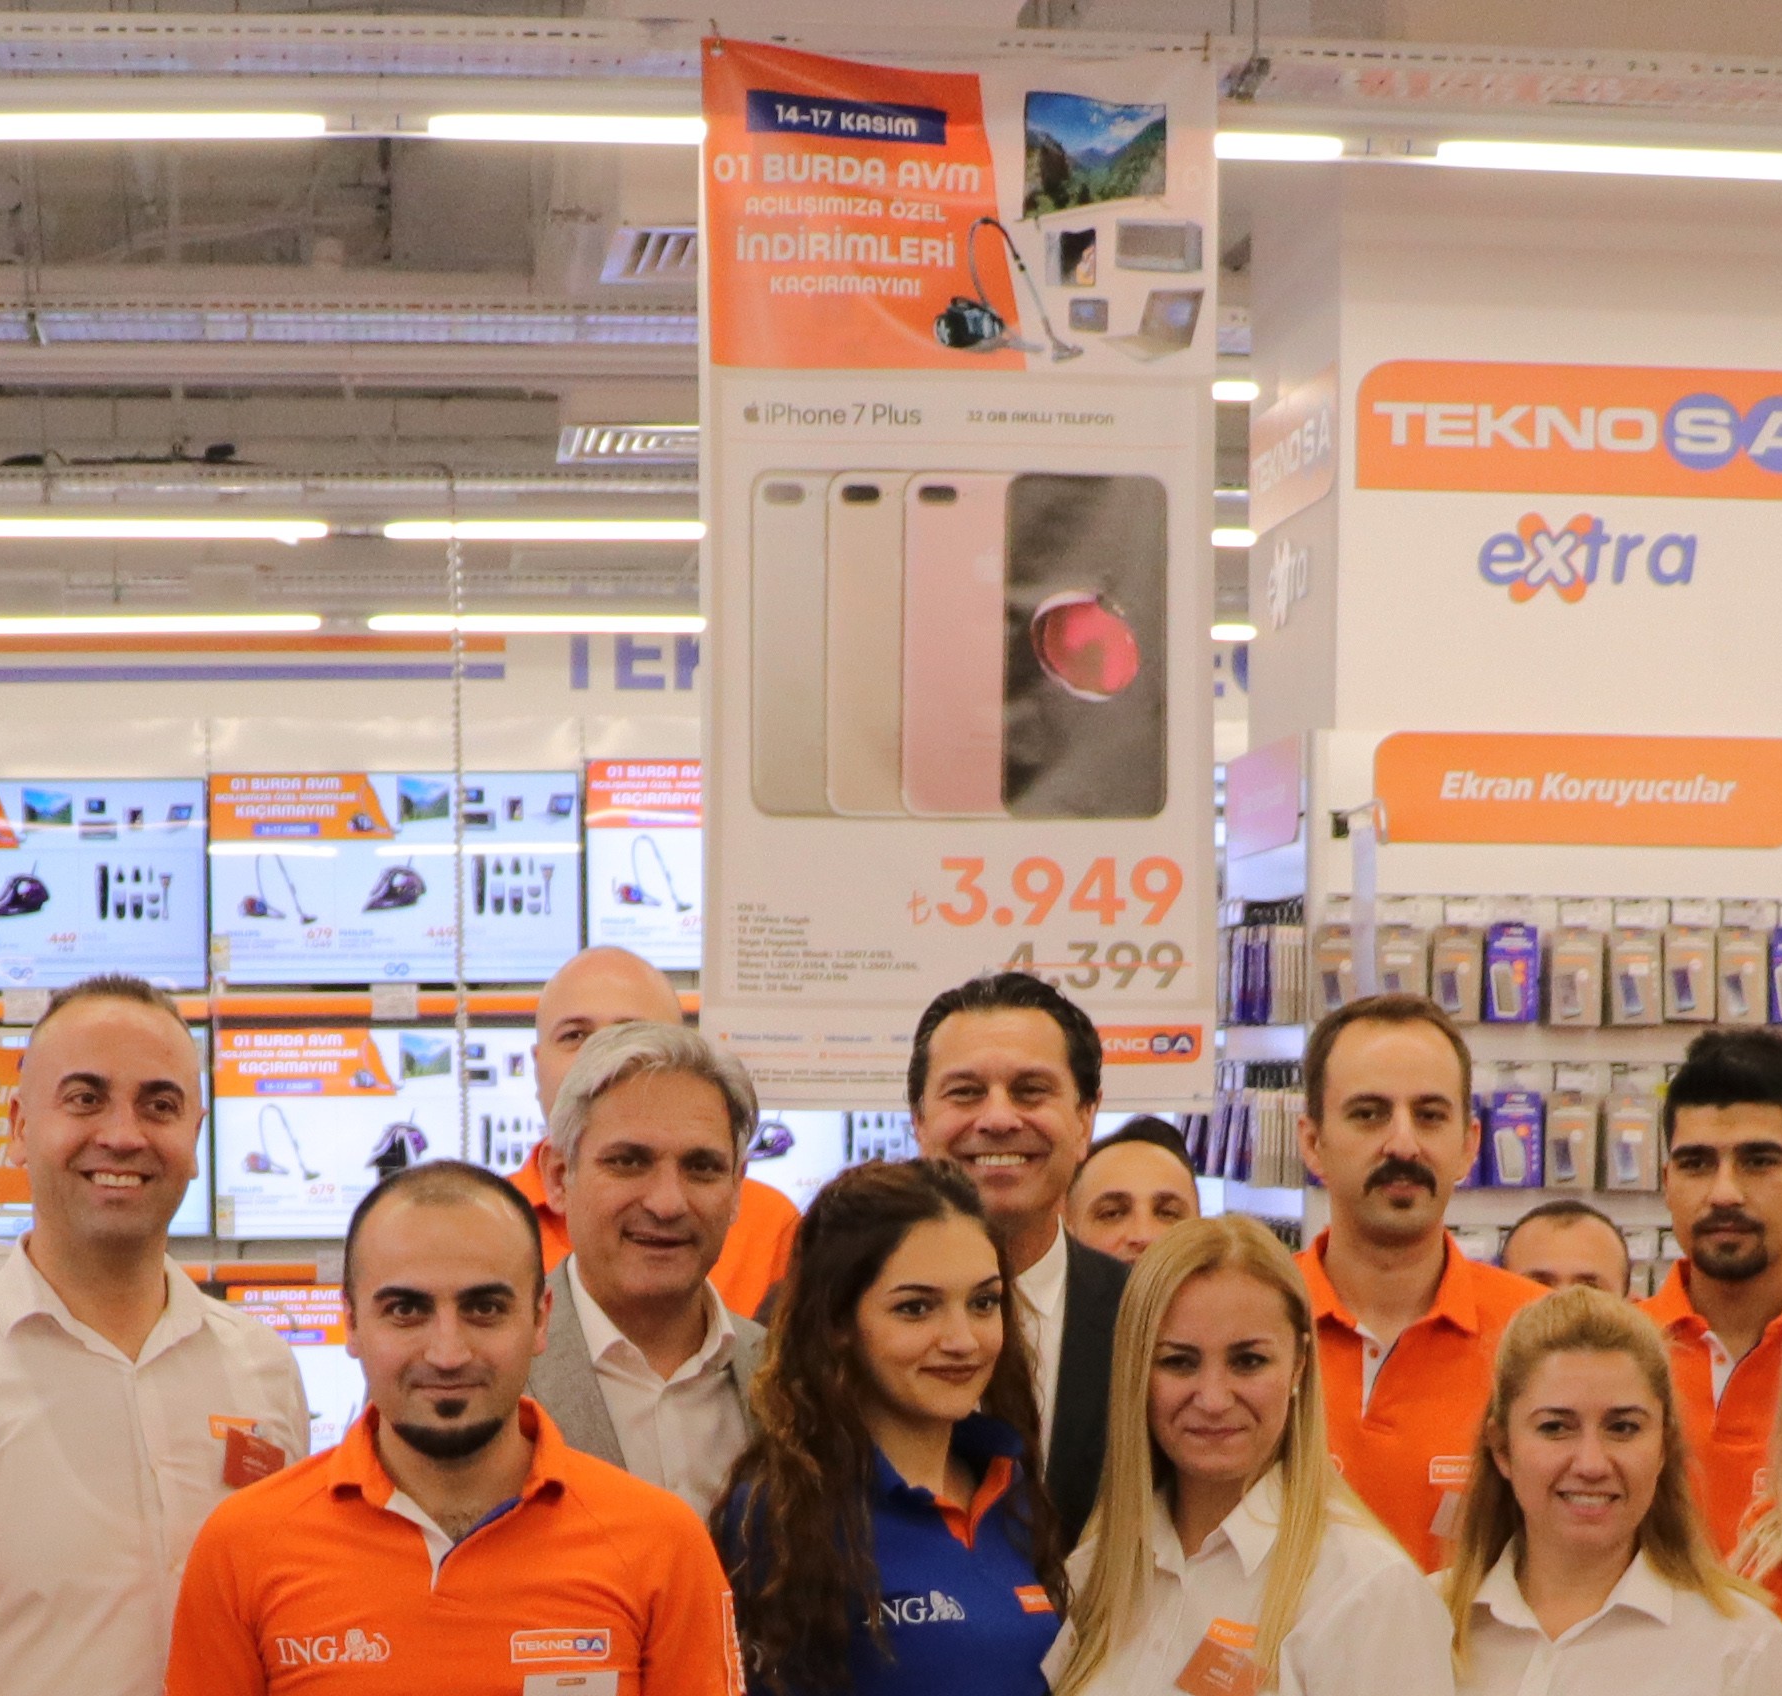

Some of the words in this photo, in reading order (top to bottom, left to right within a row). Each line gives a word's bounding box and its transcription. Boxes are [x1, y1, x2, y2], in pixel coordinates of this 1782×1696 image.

[774, 104, 833, 132] 14-17
[839, 111, 918, 138] KASIM
[713, 156, 751, 183] 01
[762, 155, 887, 187] BURDA
[897, 163, 981, 193] AVM
[744, 194, 884, 219] AÇILIŞIMIZA
[888, 196, 946, 223] ÖZEL
[735, 225, 956, 268] İNDİRİMLERİ
[770, 274, 923, 300] KAÇIRMAYIN!
[764, 404, 847, 426] iPhone
[852, 406, 867, 426] 7
[872, 405, 923, 427] Plus
[987, 411, 1007, 423] GB
[1056, 412, 1115, 426] TELEFON
[1251, 408, 1332, 495] TEKNOSA
[1478, 513, 1698, 604] extra
[230, 777, 247, 790] 01
[251, 777, 301, 790] BURDA
[305, 777, 342, 790] AVM
[606, 765, 623, 778] 01
[627, 765, 678, 778] BURDA
[681, 765, 701, 778] AV
[1439, 771, 1533, 802] Ekran
[1539, 772, 1737, 807] Koruyucular
[235, 804, 336, 819] KAÇIRMAYIN!
[233, 1034, 251, 1047] 01
[254, 1034, 304, 1047] BURDA
[307, 1033, 343, 1046] AVM
[238, 1060, 338, 1075] KAÇIRMAYIN!
[864, 1596, 929, 1626] NG
[276, 1636, 339, 1665] ING
[514, 1638, 604, 1652] TEKNOSA
